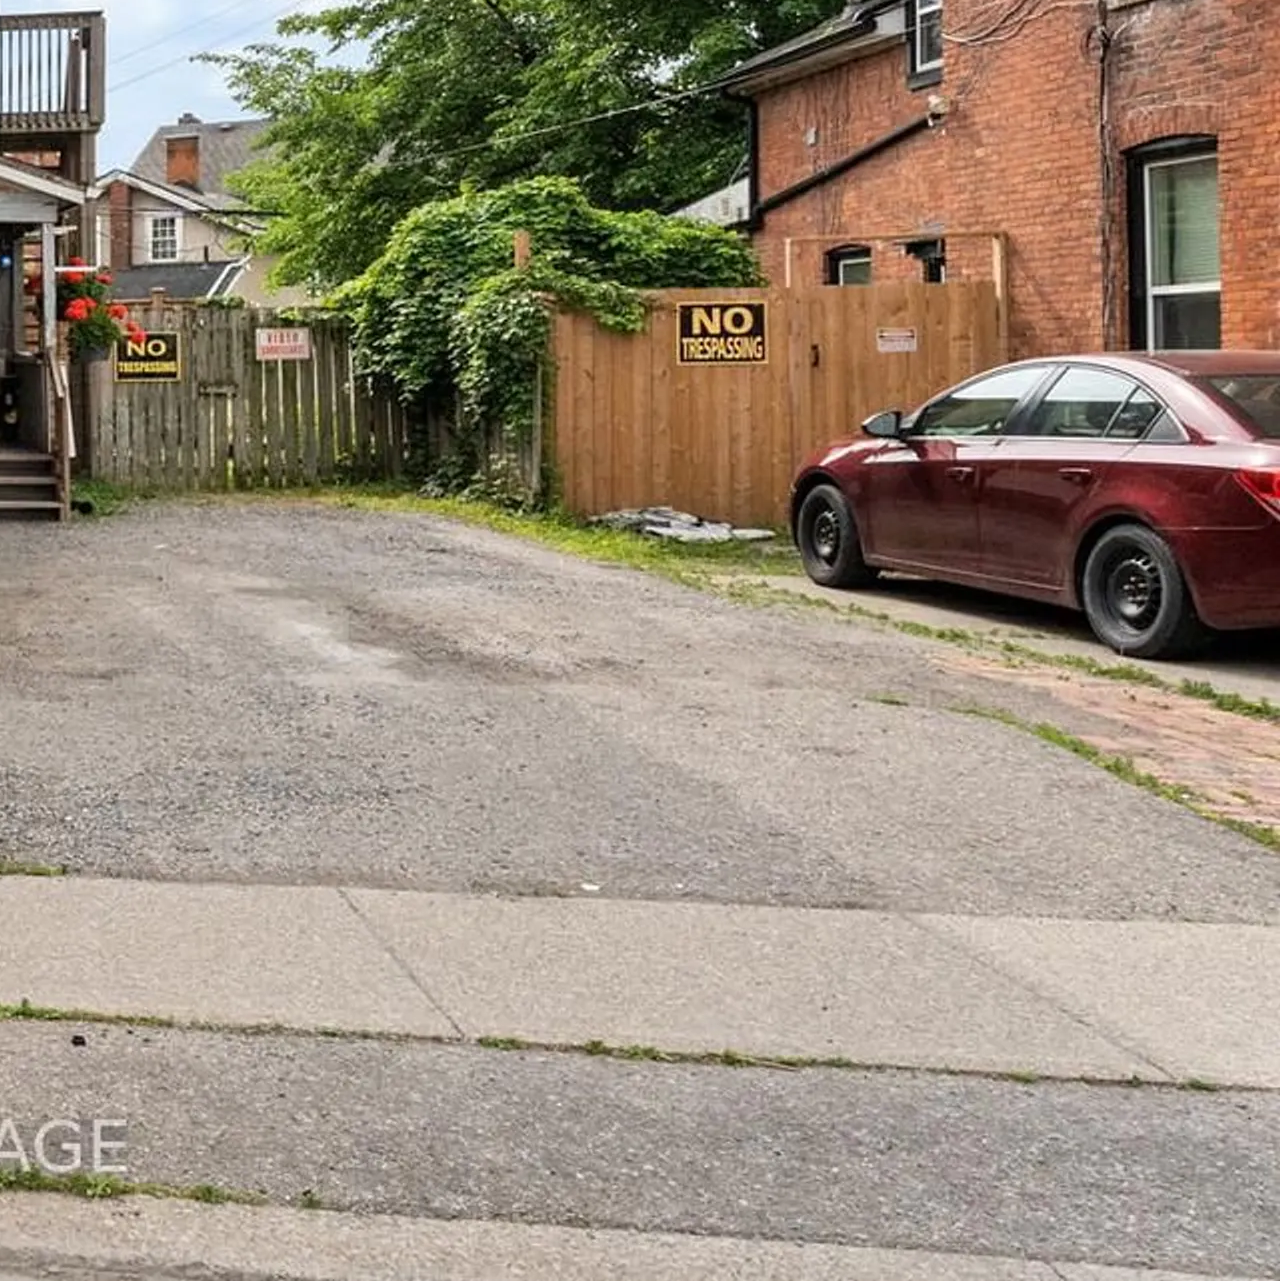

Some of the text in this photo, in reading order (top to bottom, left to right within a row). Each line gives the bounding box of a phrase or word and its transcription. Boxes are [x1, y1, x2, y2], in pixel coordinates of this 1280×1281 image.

[692, 306, 754, 335] NO
[126, 337, 168, 356] NO
[682, 336, 763, 359] TRESPASSING
